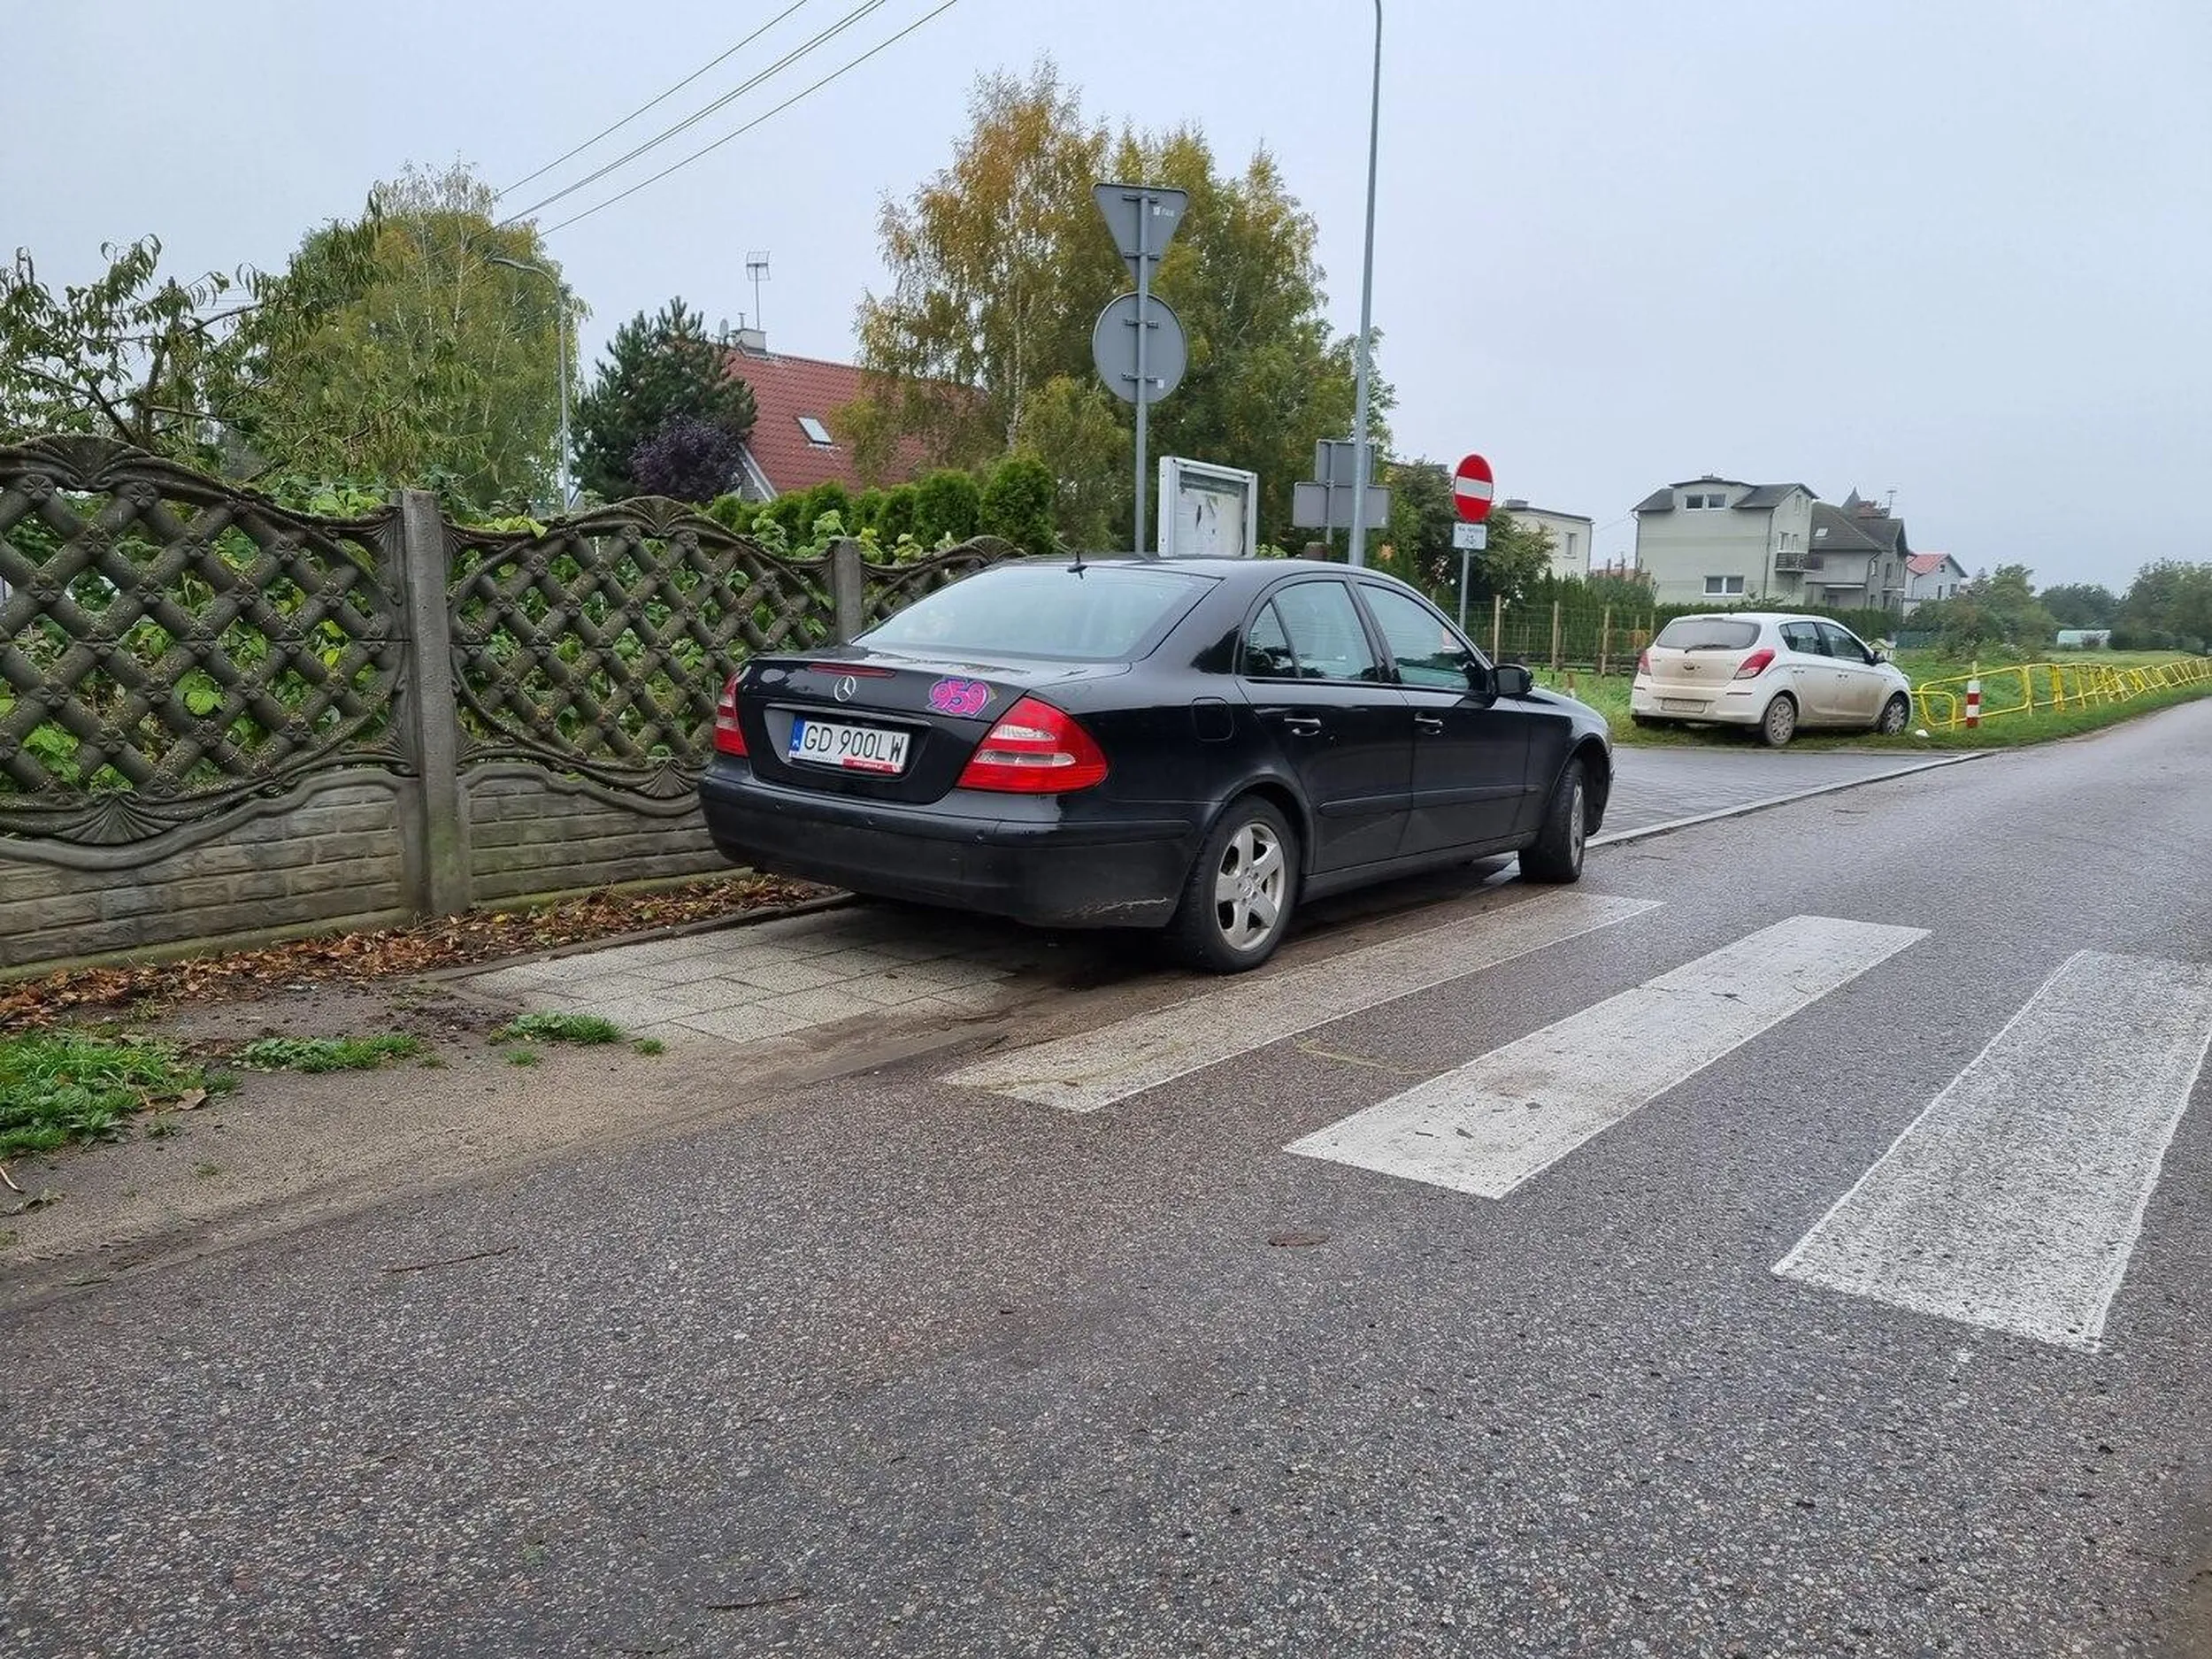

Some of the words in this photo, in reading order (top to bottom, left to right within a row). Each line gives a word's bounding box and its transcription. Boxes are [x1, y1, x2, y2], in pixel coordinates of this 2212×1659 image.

[927, 678, 987, 716] 959
[804, 725, 833, 752] GD
[837, 730, 904, 763] 900LW
